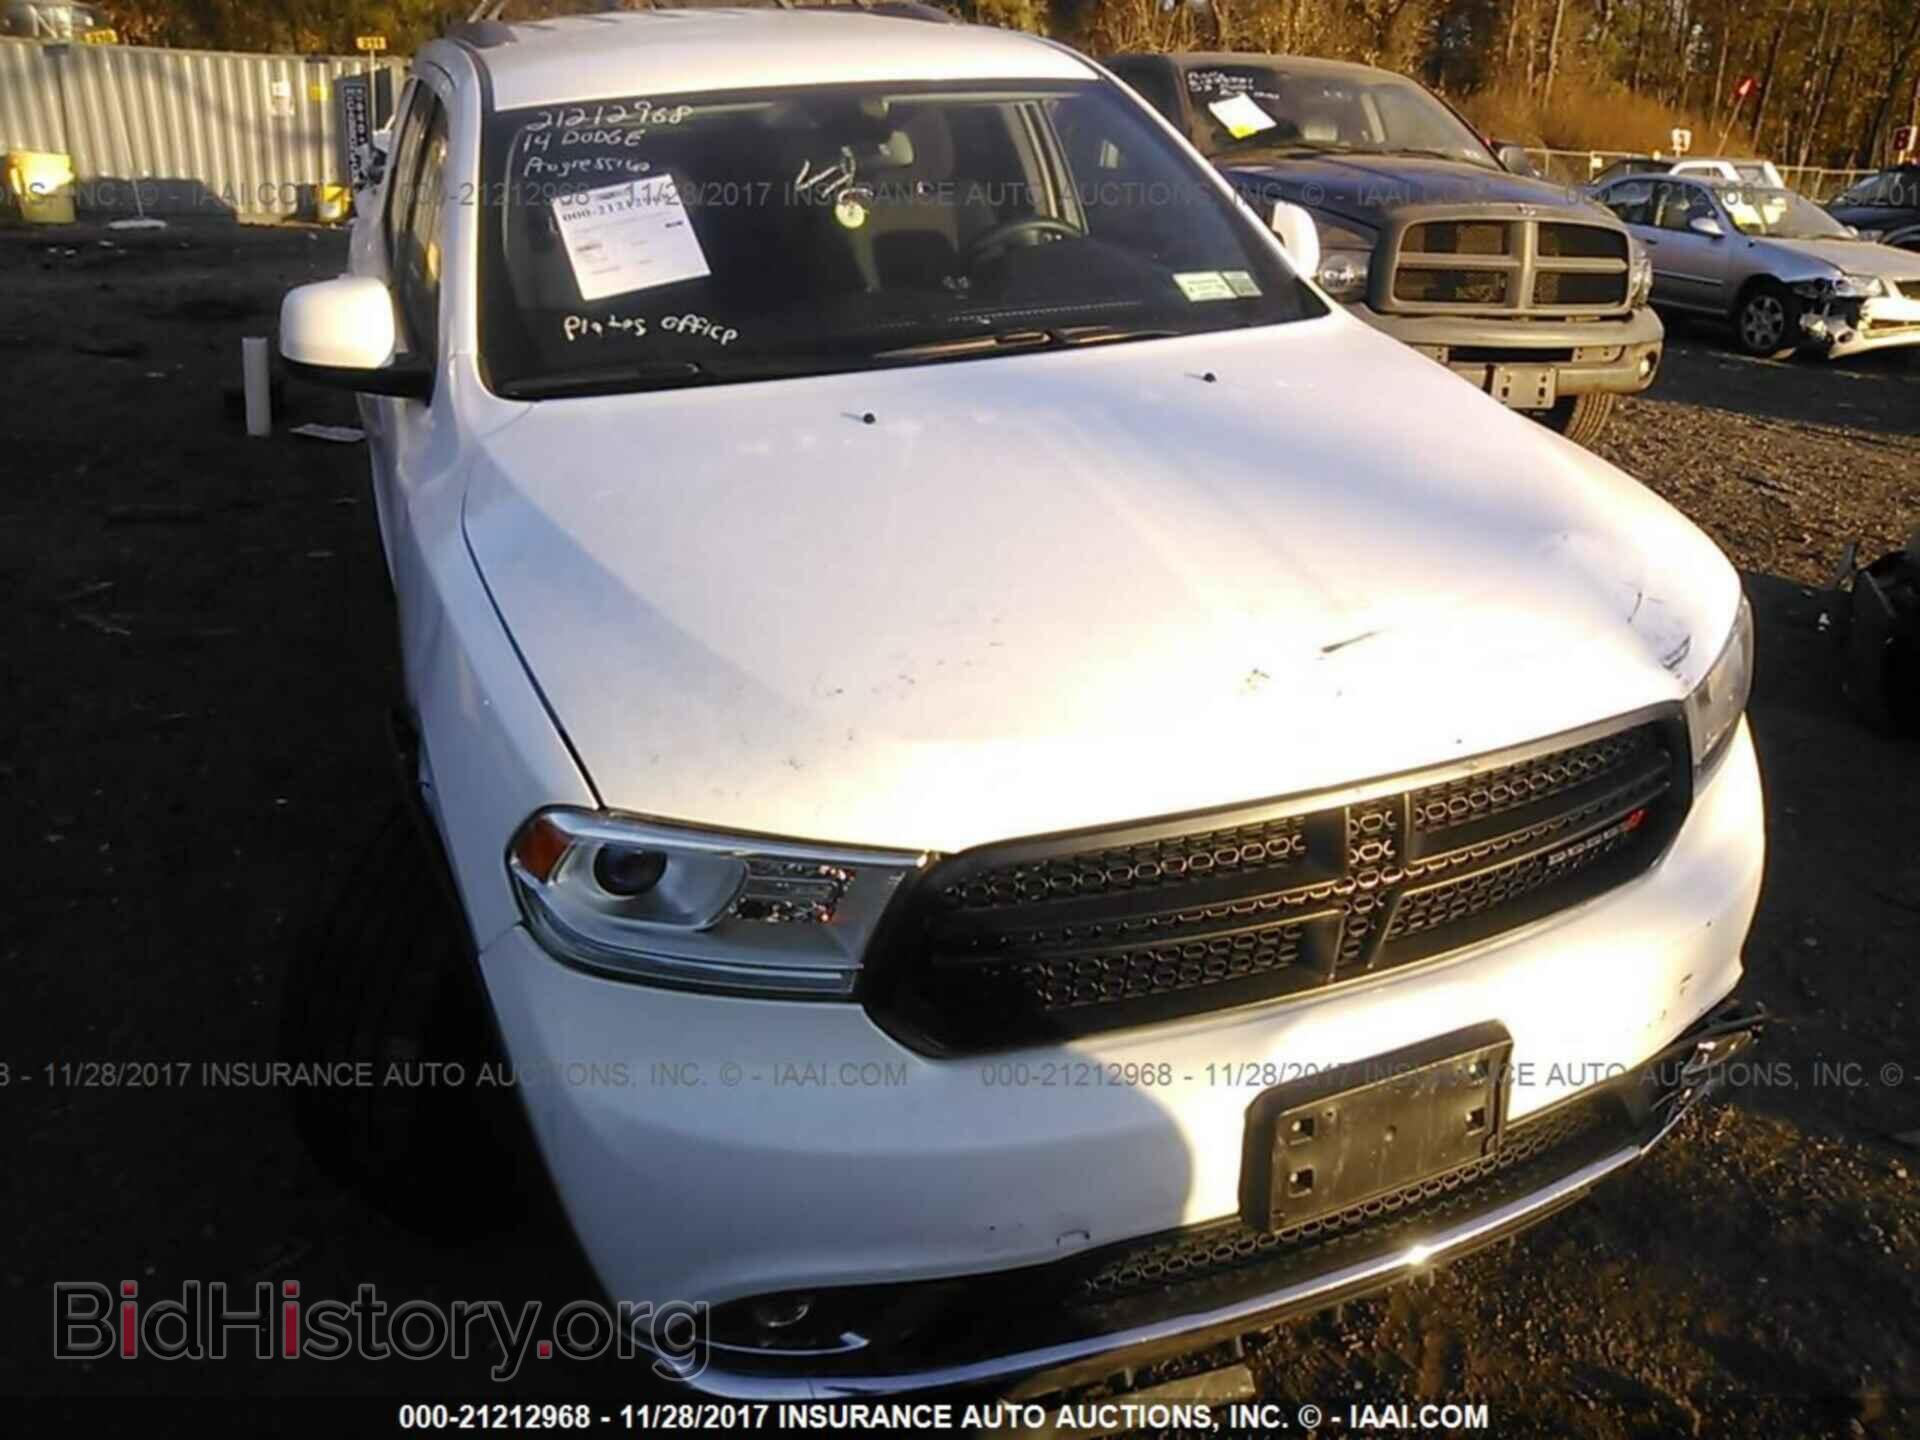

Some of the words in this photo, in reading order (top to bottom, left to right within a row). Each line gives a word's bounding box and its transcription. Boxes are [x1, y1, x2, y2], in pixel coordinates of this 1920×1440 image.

[525, 100, 694, 131] 21212968
[523, 132, 552, 152] 14
[561, 129, 646, 147] DODGE
